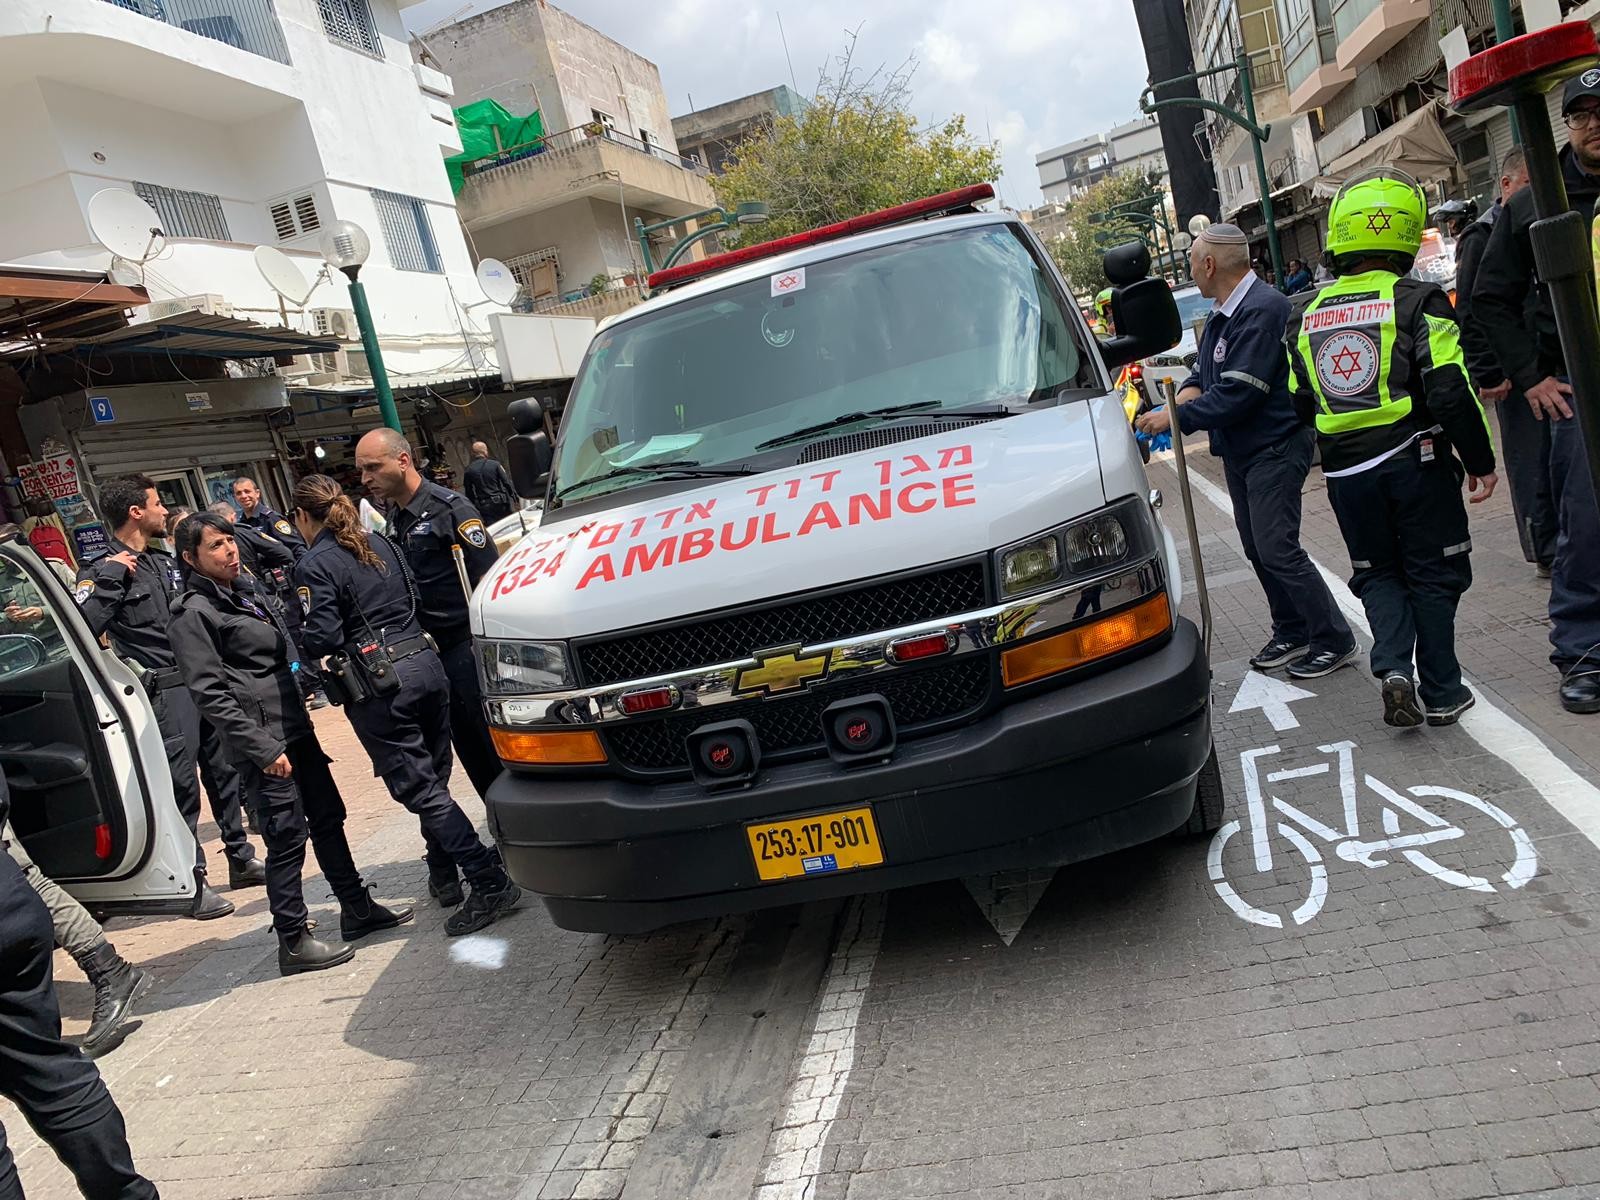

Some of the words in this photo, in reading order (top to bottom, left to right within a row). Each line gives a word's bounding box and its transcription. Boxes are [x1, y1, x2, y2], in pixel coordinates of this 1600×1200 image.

[1304, 307, 1354, 331] האופנועים
[1357, 302, 1392, 321] יחידת
[1321, 368, 1331, 386] MAGEN
[1331, 382, 1346, 391] DAVID
[1346, 383, 1361, 391] ADOM
[1365, 361, 1374, 380] ISRAEL
[97, 402, 106, 417] 9
[41, 472, 65, 489] RENT
[874, 444, 973, 486] מגן
[746, 469, 841, 507] דוד
[575, 472, 977, 591] AMBULANCE
[588, 497, 717, 549] אדום
[490, 549, 567, 602] 1324
